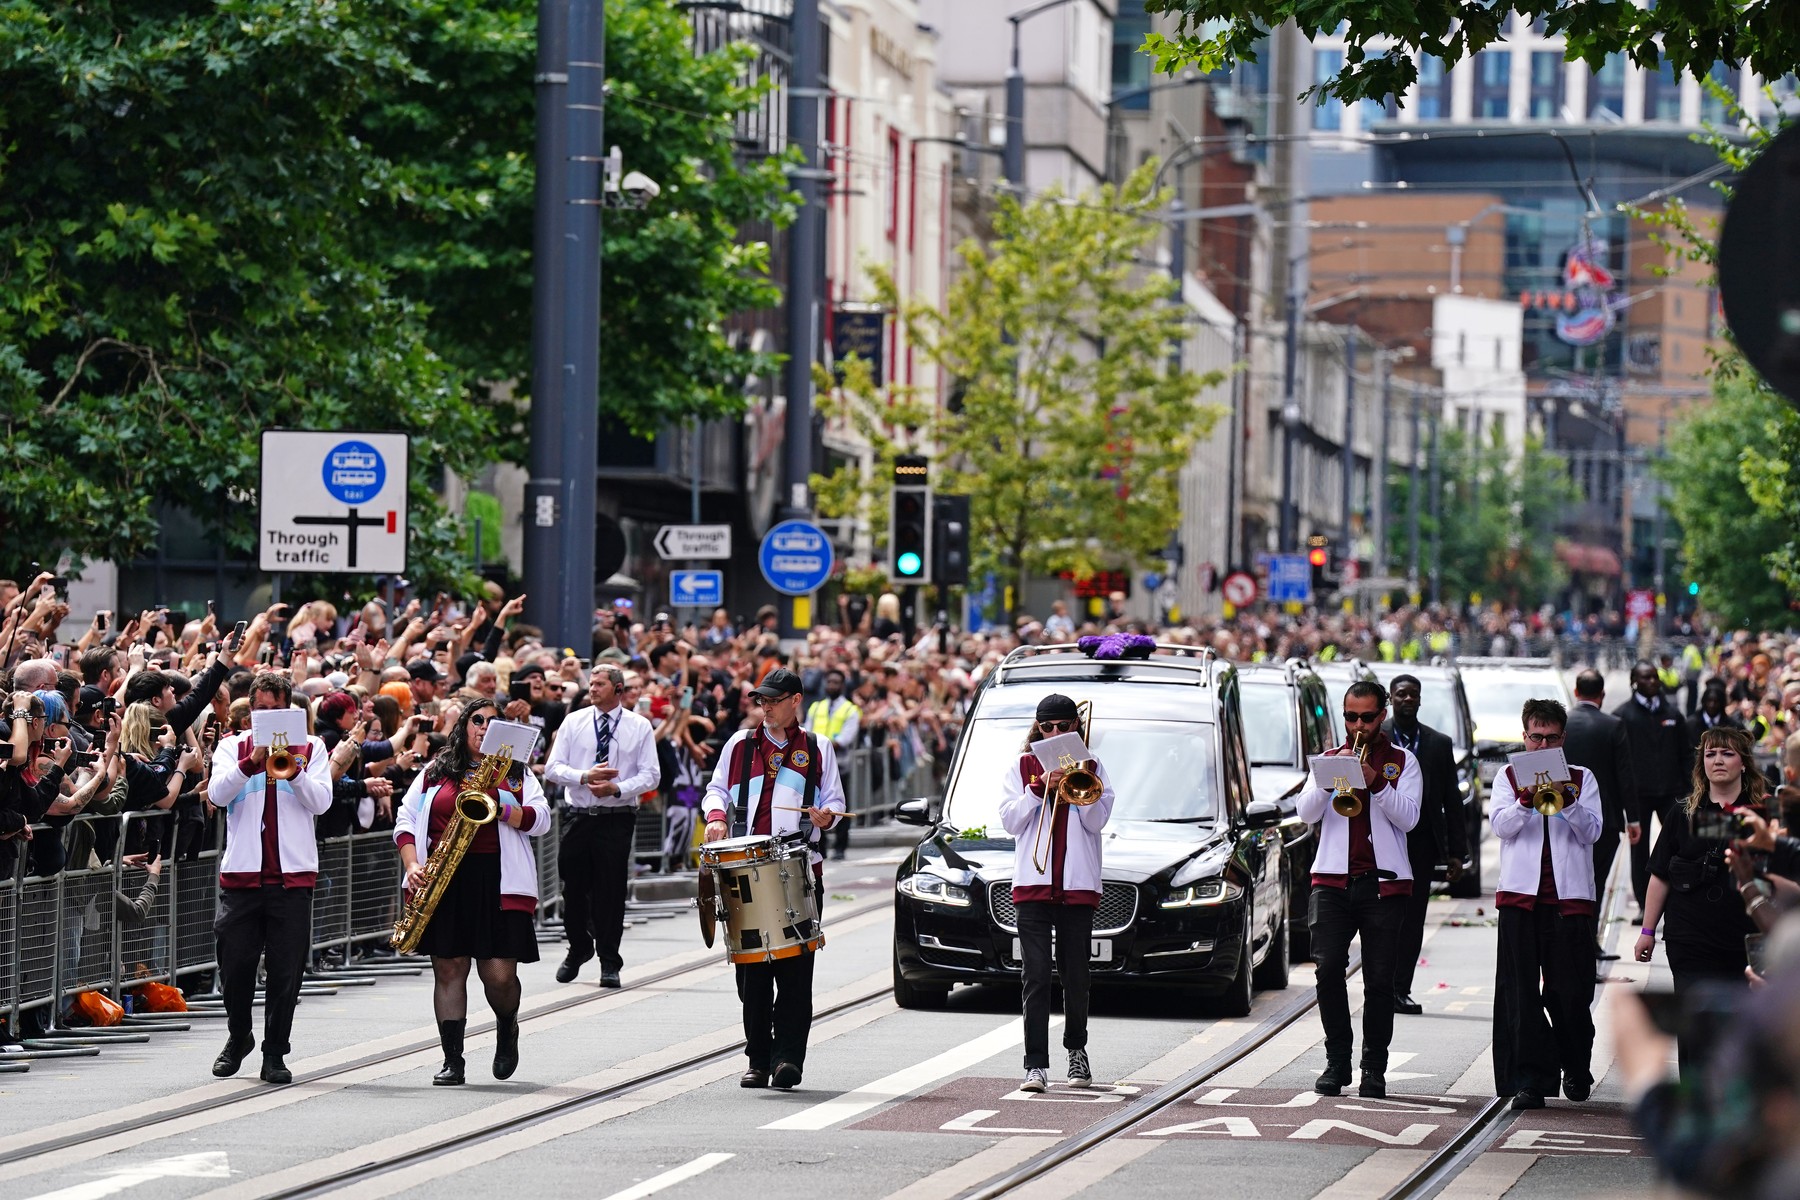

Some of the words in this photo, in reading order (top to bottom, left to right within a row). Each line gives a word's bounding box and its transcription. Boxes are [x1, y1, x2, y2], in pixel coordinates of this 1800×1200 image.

[267, 530, 338, 547] Through
[676, 530, 726, 541] Through
[682, 543, 719, 553] traffic
[276, 549, 330, 563] traffic
[938, 1109, 1646, 1153] LANE
